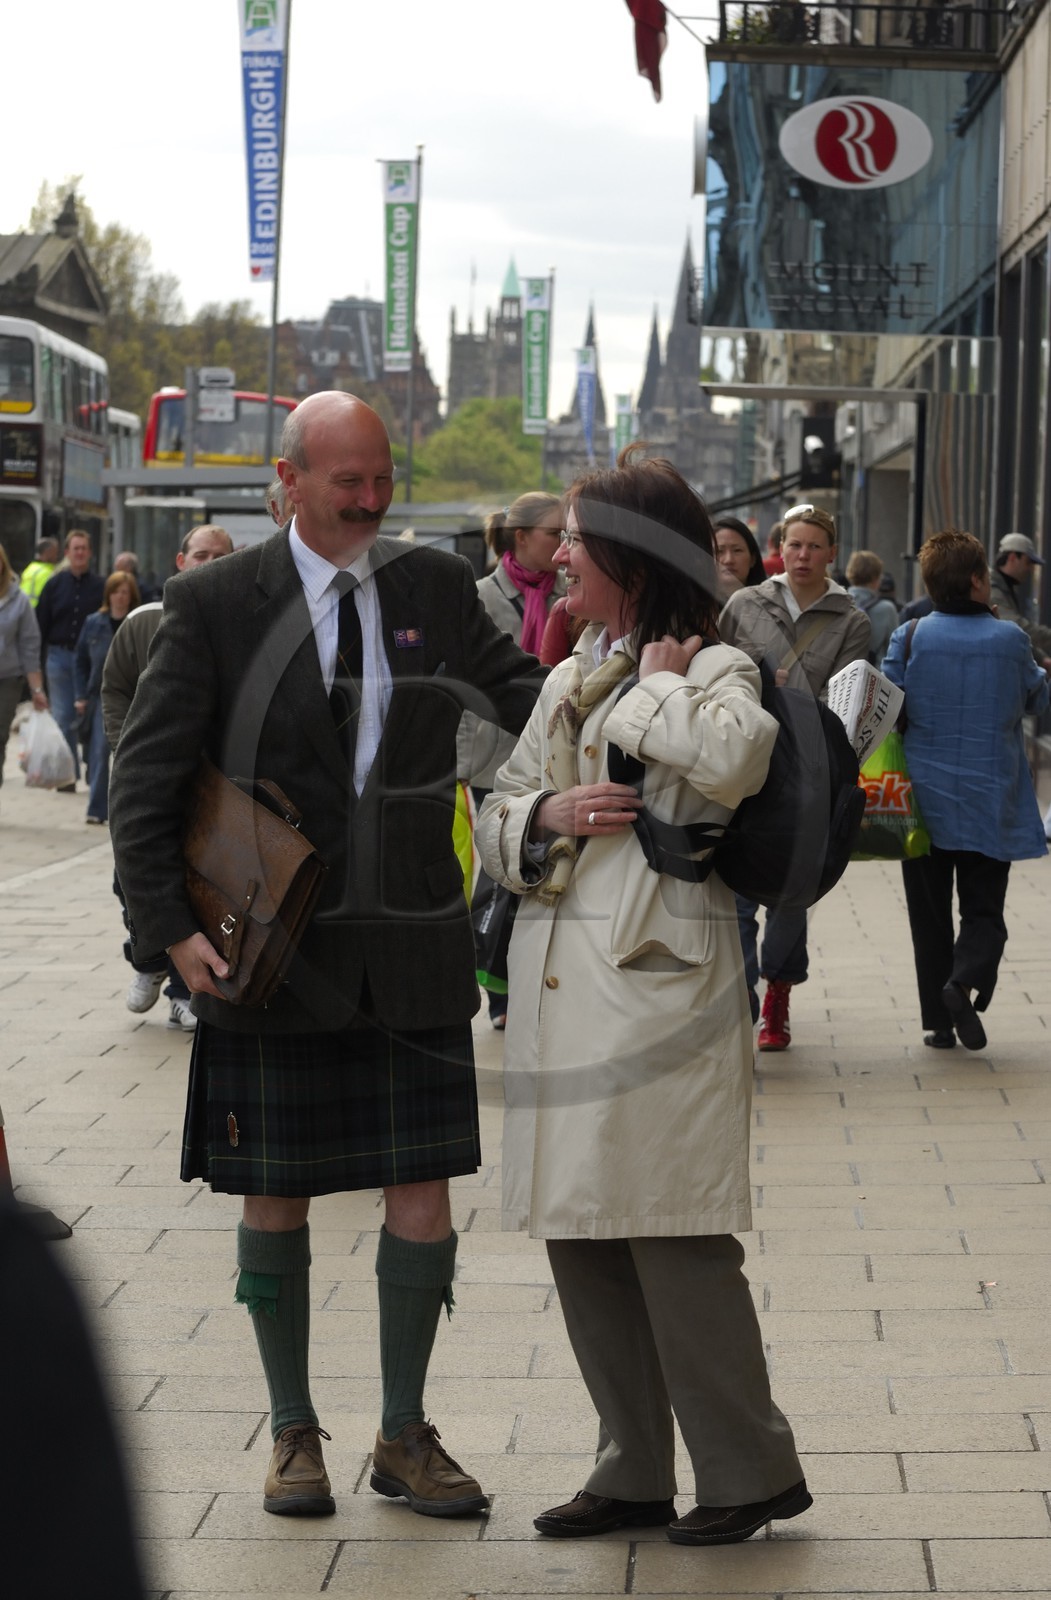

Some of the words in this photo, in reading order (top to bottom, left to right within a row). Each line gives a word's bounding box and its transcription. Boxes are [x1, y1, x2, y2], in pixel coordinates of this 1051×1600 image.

[248, 69, 279, 239] EDINBURGH
[389, 206, 412, 247] Cup
[779, 259, 927, 289] MOUNT
[389, 251, 409, 348] Heineken
[842, 667, 859, 717] Women
[870, 687, 892, 728] THE
[855, 725, 873, 753] SC
[858, 771, 912, 816] sk
